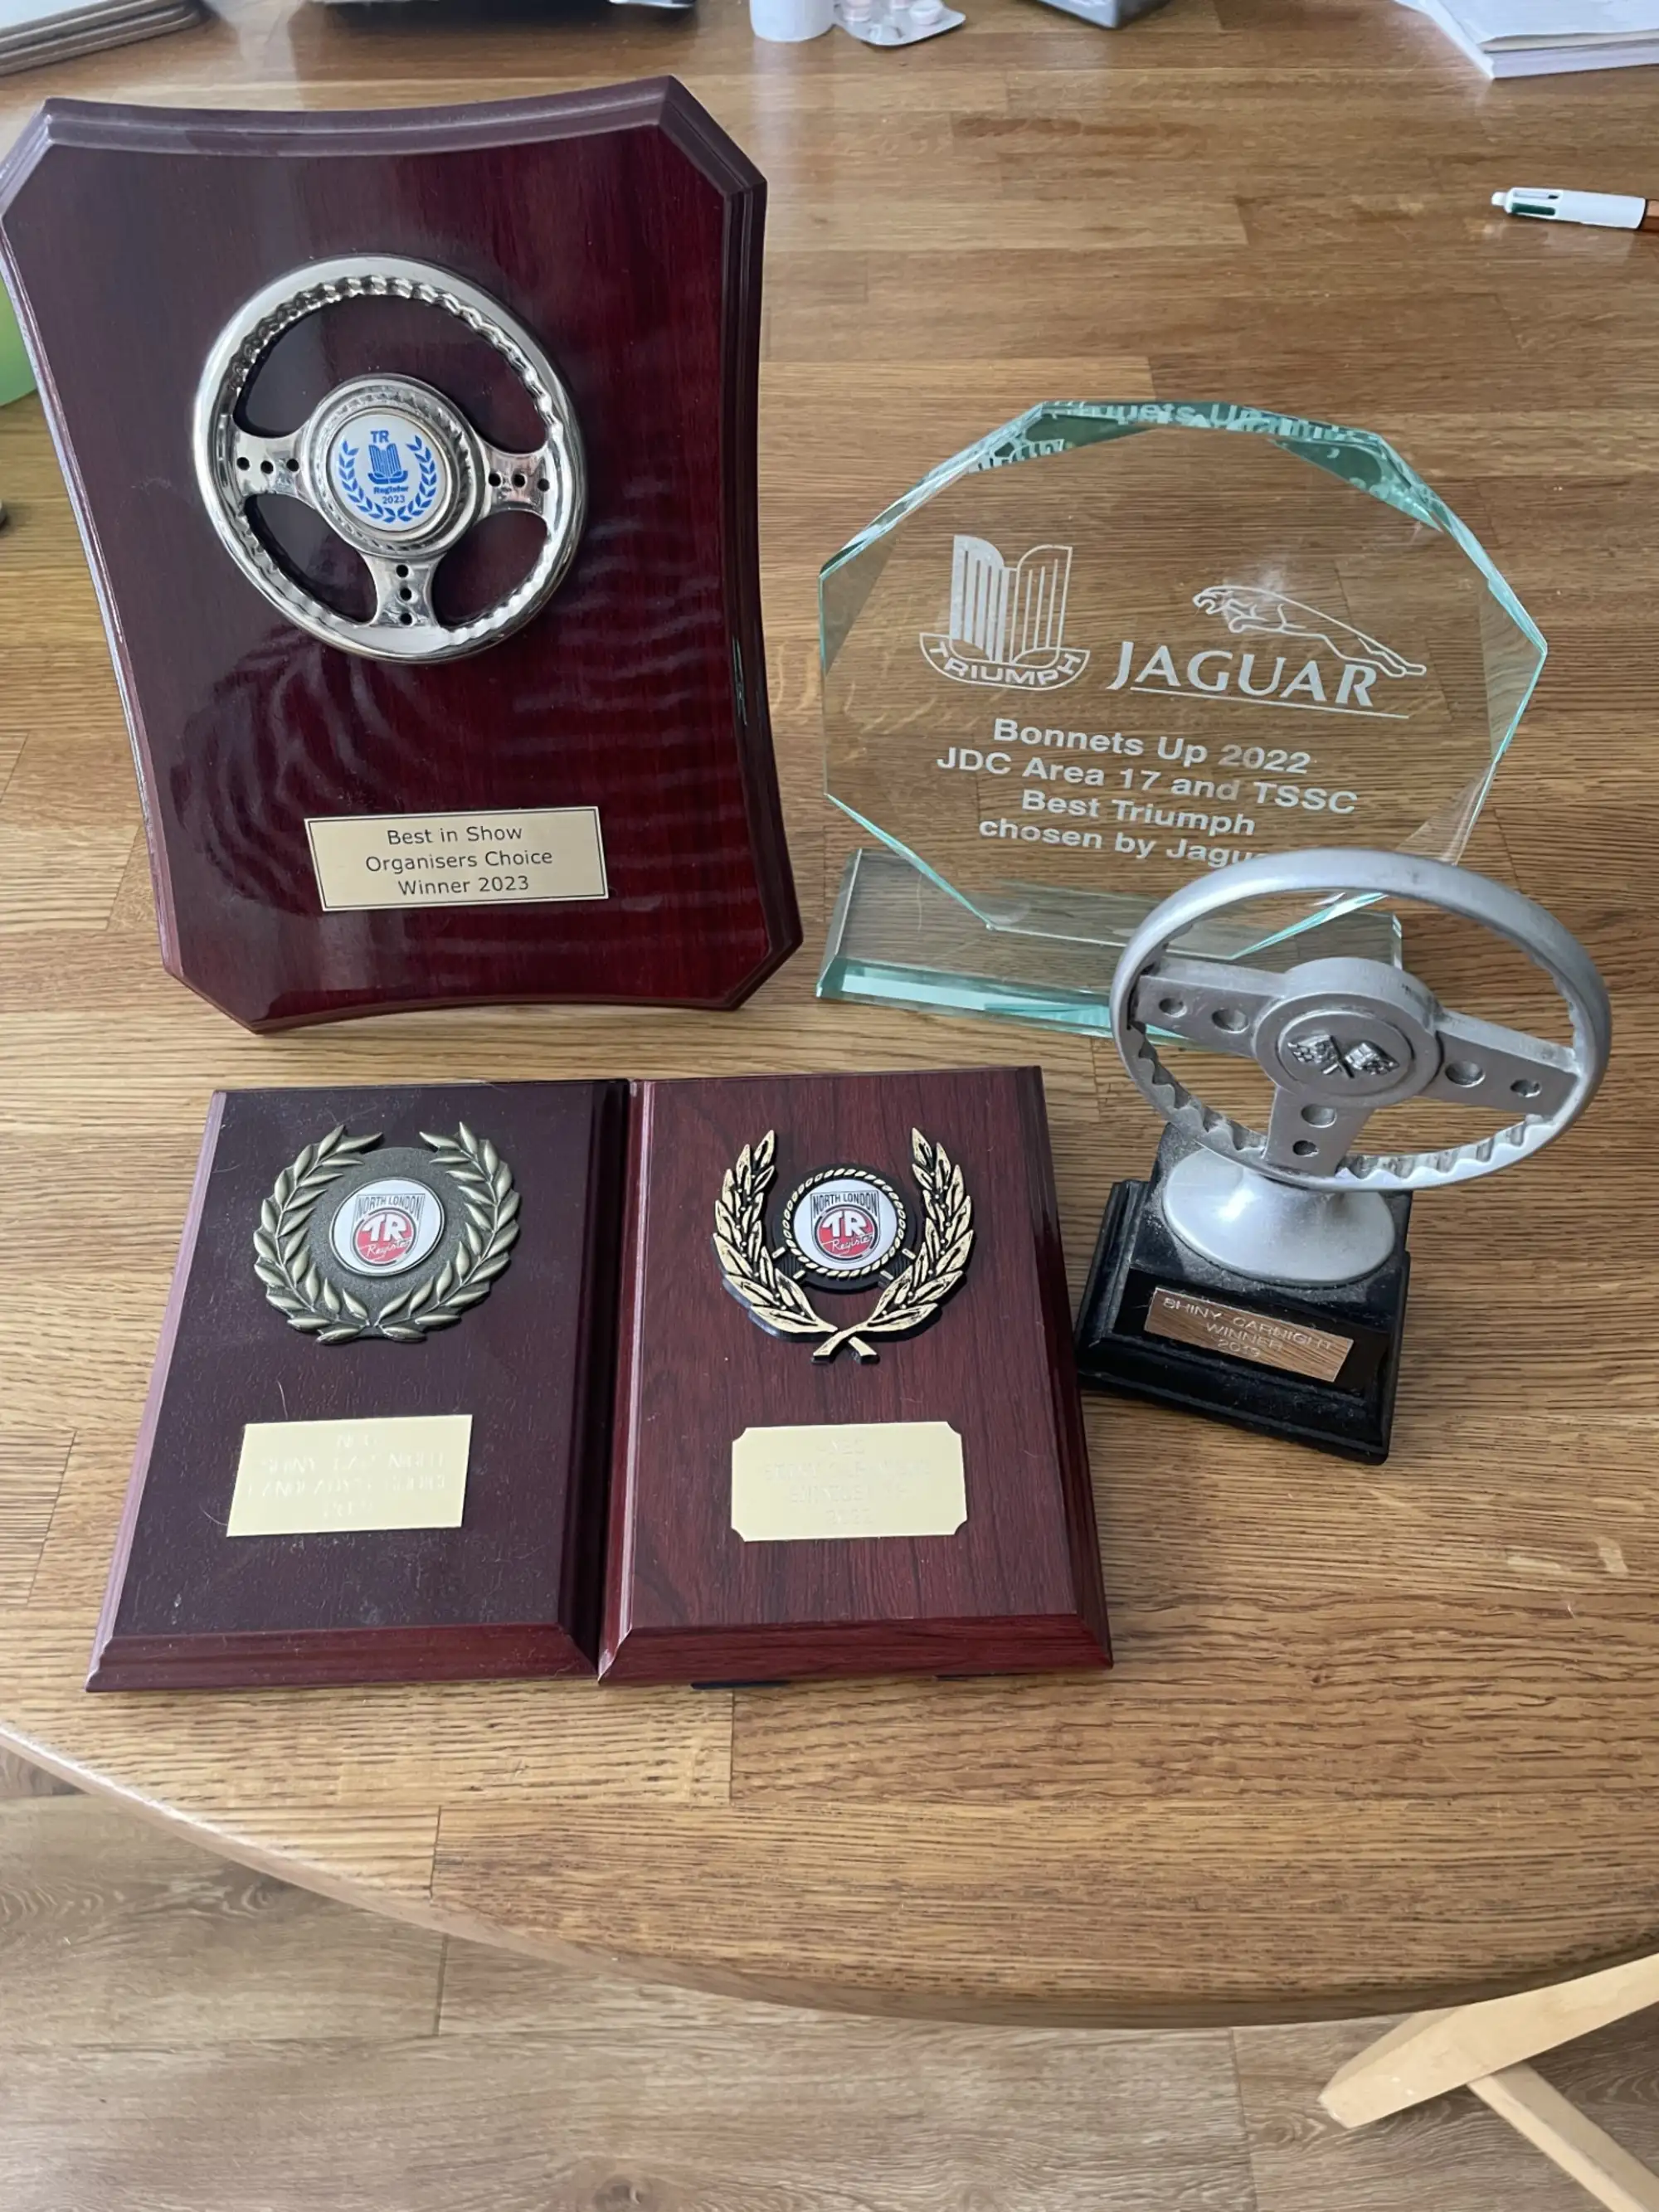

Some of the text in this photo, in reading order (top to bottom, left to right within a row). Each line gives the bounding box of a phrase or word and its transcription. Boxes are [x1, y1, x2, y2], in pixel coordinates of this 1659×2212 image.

[370, 430, 390, 443] TR
[382, 495, 406, 504] 2023
[928, 641, 1082, 686] TRIUMPH
[1105, 640, 1377, 707] JAGUAR
[994, 717, 1311, 774] Bonnets Up 2022
[937, 747, 1358, 814] JDC Area 17 and TSSC
[1022, 789, 1256, 837] Best Triumph
[387, 825, 523, 845] Best in Show
[979, 818, 1270, 868] chosen by Jagu
[365, 849, 554, 874] Organisers Choice
[397, 876, 529, 897] Winner 2023
[358, 1194, 422, 1221] NORTH LONDON
[812, 1192, 878, 1218] NORTH LONDON
[362, 1214, 407, 1242] TR
[822, 1211, 867, 1237] TR
[1163, 1296, 1223, 1319] SHINY
[1206, 1322, 1284, 1352] WINNER
